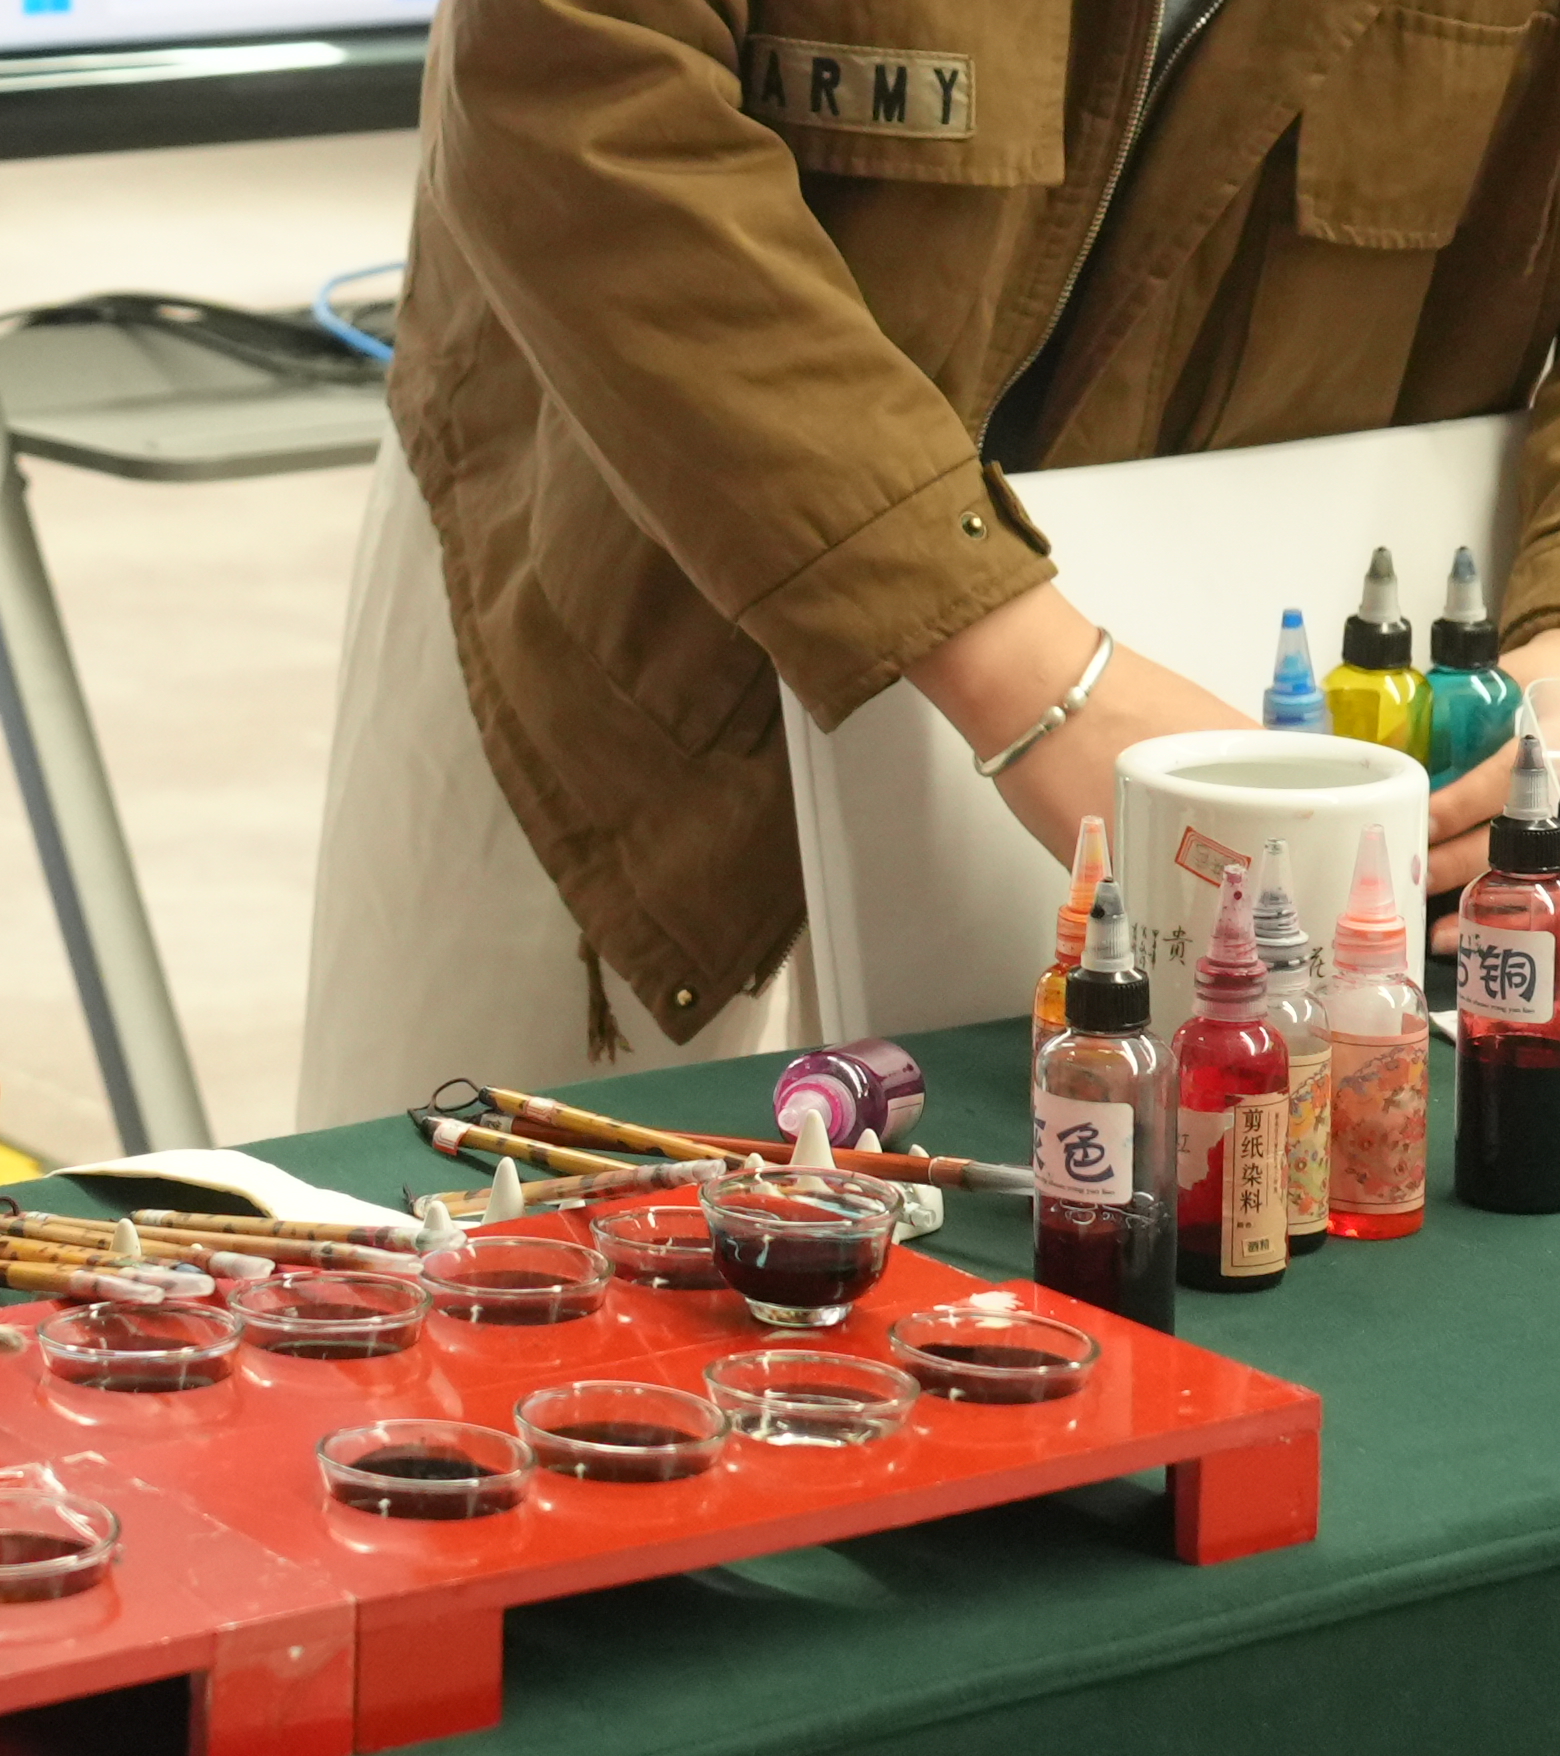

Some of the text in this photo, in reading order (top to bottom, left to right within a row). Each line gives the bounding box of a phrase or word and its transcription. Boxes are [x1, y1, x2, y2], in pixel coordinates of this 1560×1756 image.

[759, 55, 960, 126] ARMY
[1240, 1108, 1264, 1214] 剪纸染料
